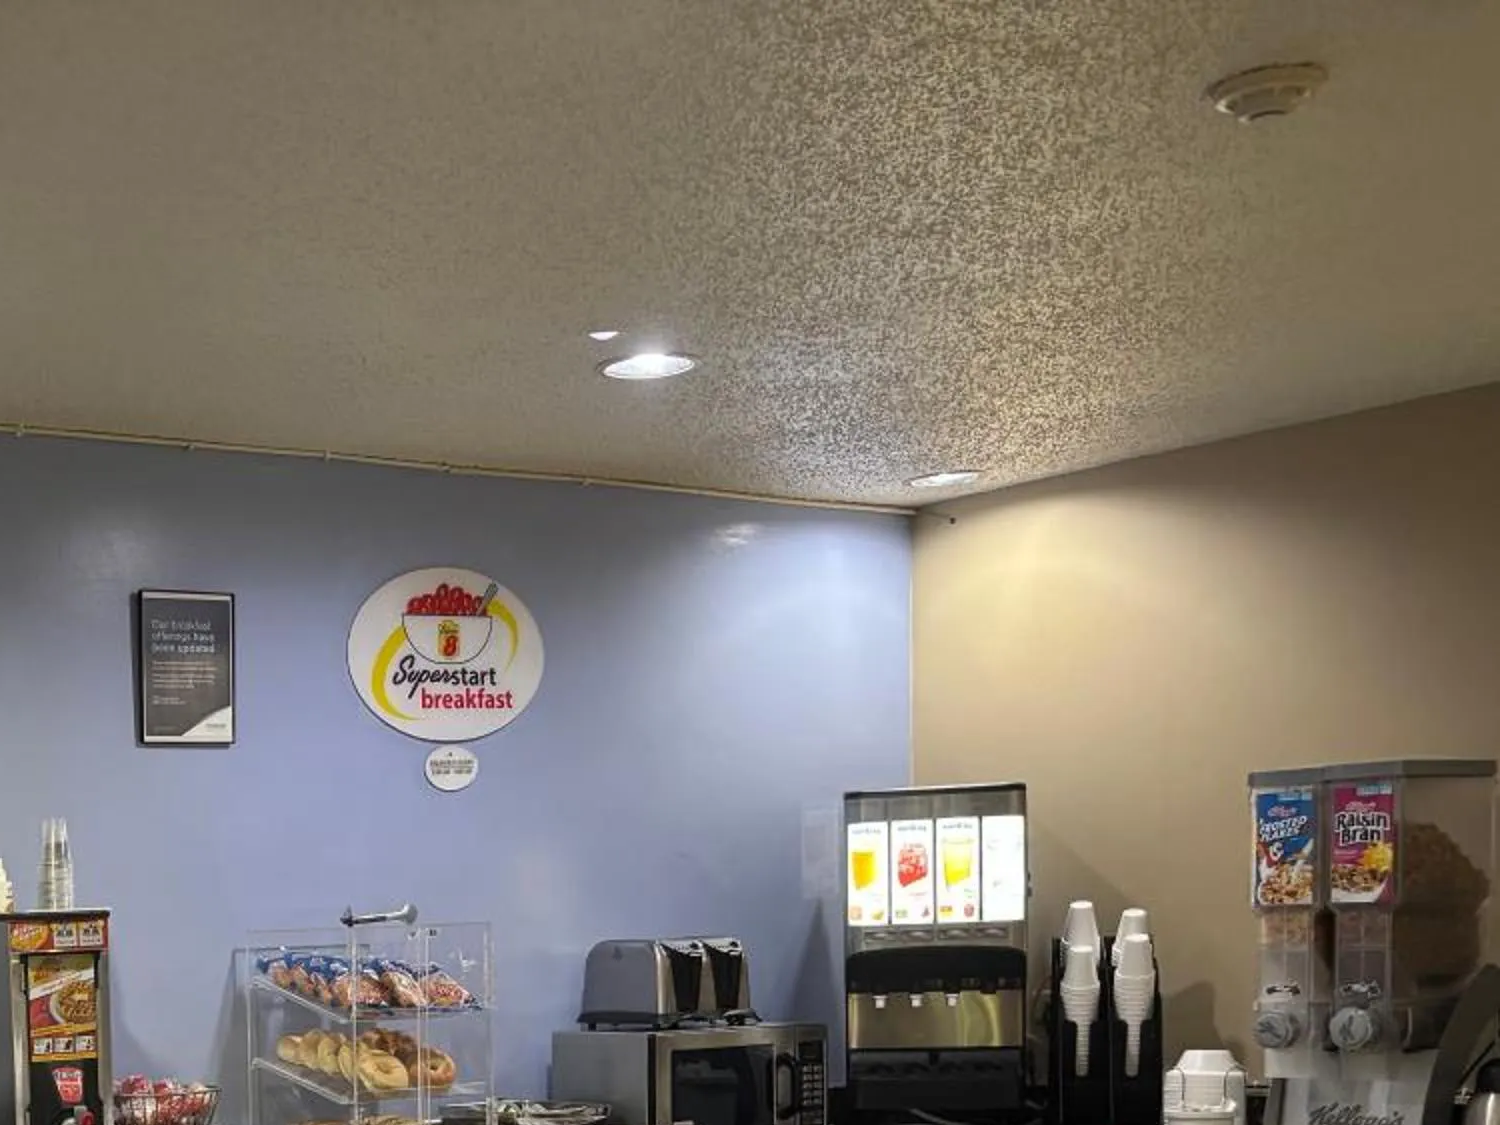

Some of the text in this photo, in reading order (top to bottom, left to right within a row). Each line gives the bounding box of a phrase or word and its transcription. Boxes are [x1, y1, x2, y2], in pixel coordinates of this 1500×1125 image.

[392, 653, 498, 700] Superstart
[421, 687, 513, 709] breakfast
[1338, 811, 1389, 831] Raisin
[1341, 829, 1383, 845] Bran
